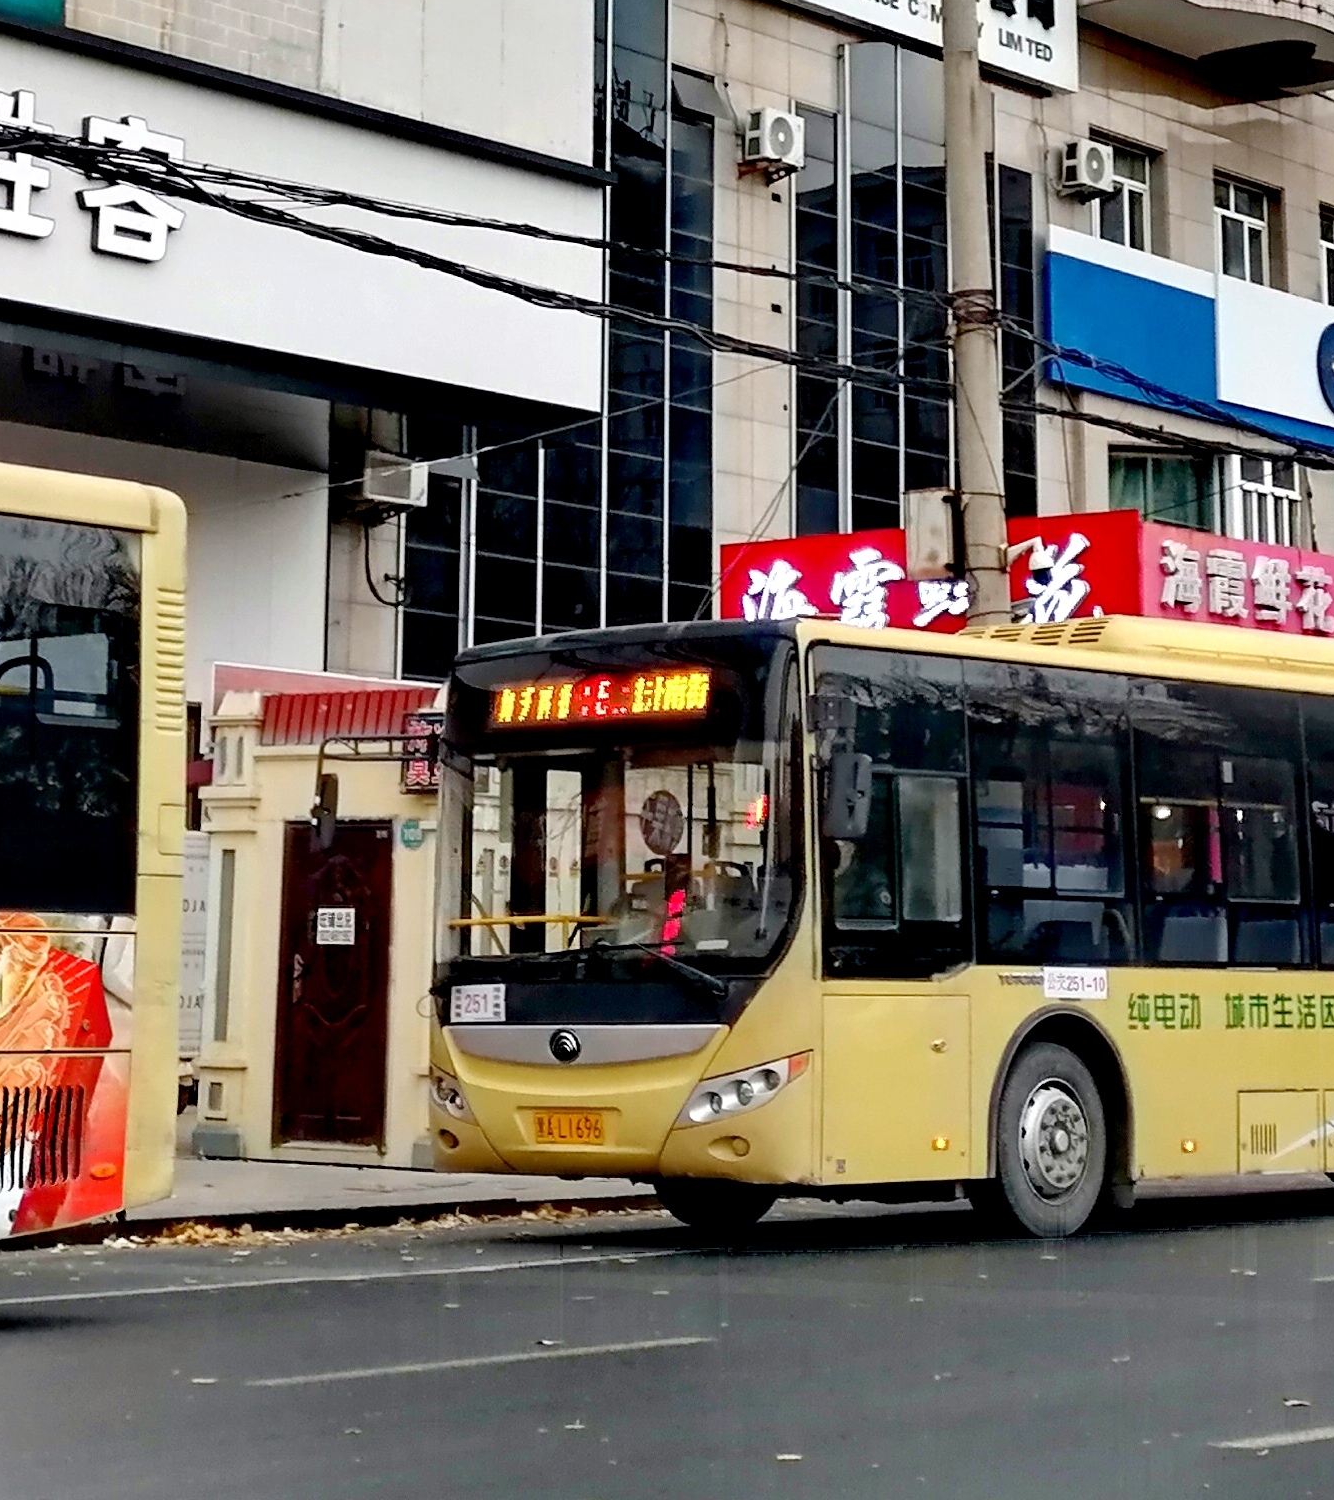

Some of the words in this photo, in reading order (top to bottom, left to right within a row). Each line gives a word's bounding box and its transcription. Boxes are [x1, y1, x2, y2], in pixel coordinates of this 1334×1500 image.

[464, 994, 488, 1014] 251
[1128, 993, 1201, 1030] 纯电动
